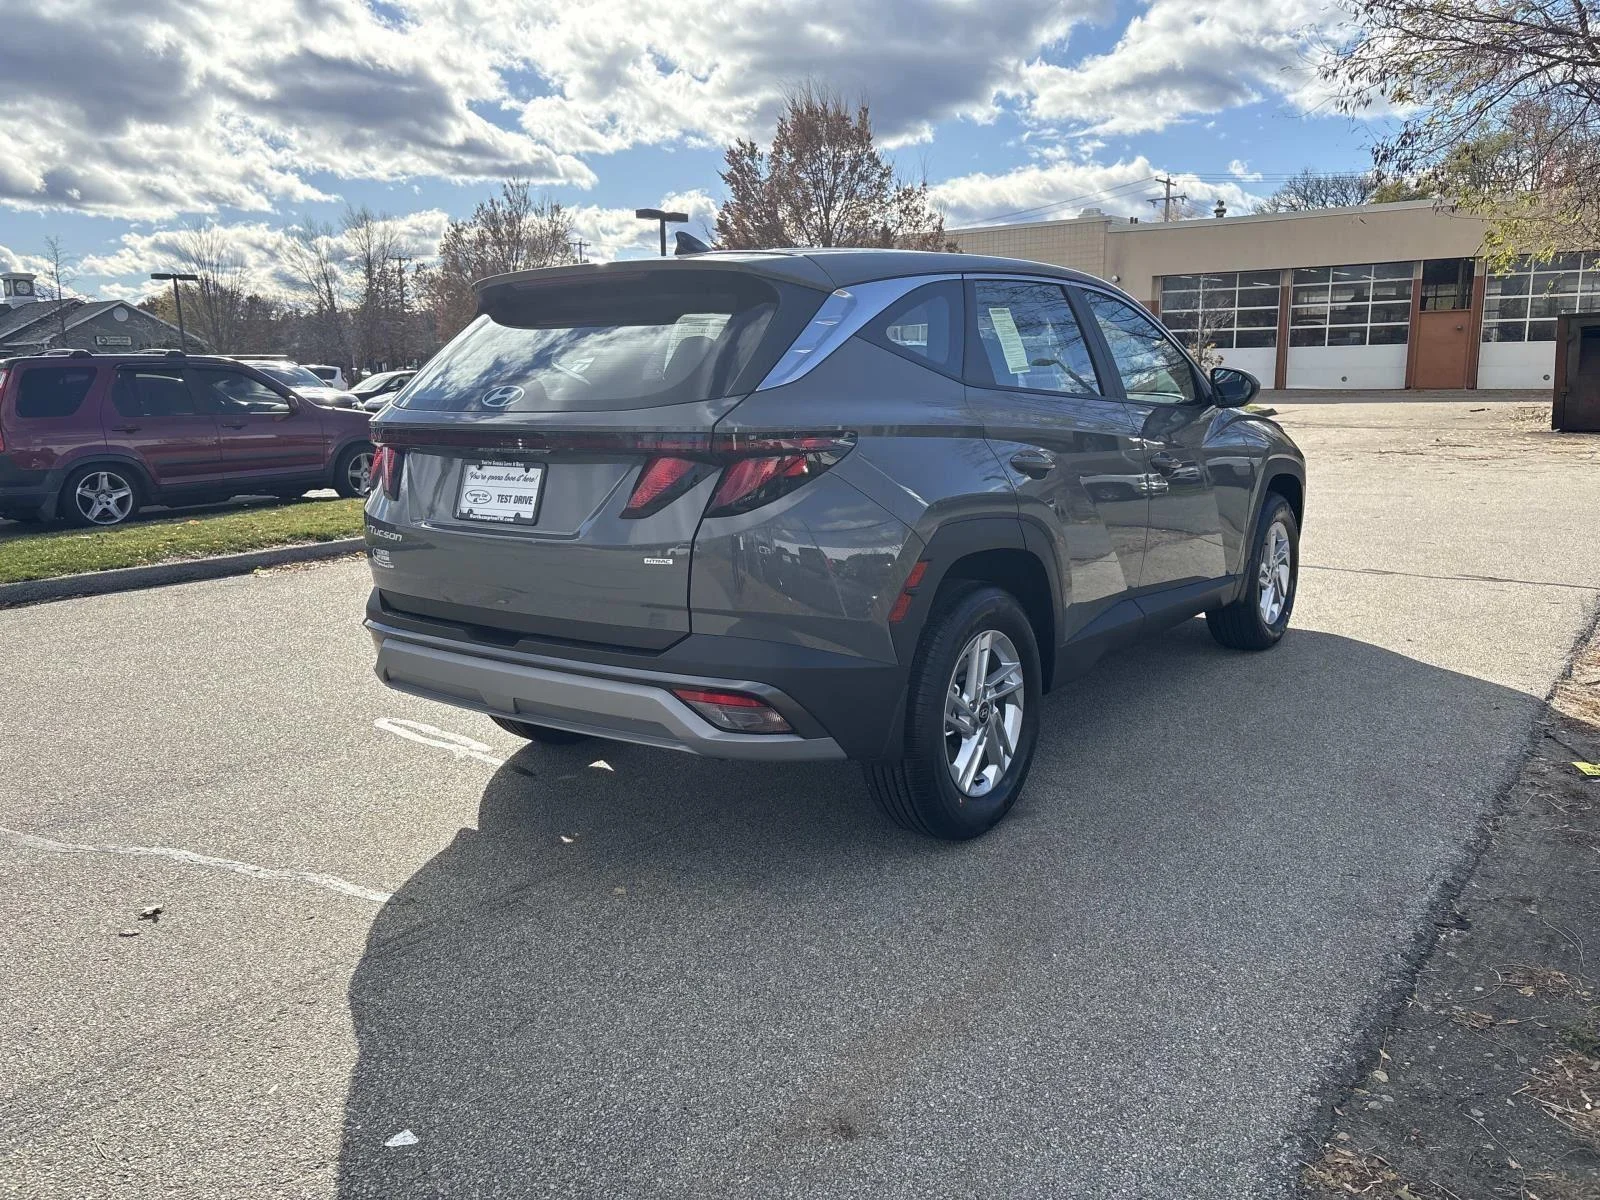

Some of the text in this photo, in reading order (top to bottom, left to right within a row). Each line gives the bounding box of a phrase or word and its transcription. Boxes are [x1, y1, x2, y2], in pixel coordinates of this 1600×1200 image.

[470, 472, 486, 480] You're
[487, 474, 504, 483] gonna
[504, 473, 516, 481] love
[497, 494, 534, 505] TEST DRIVE
